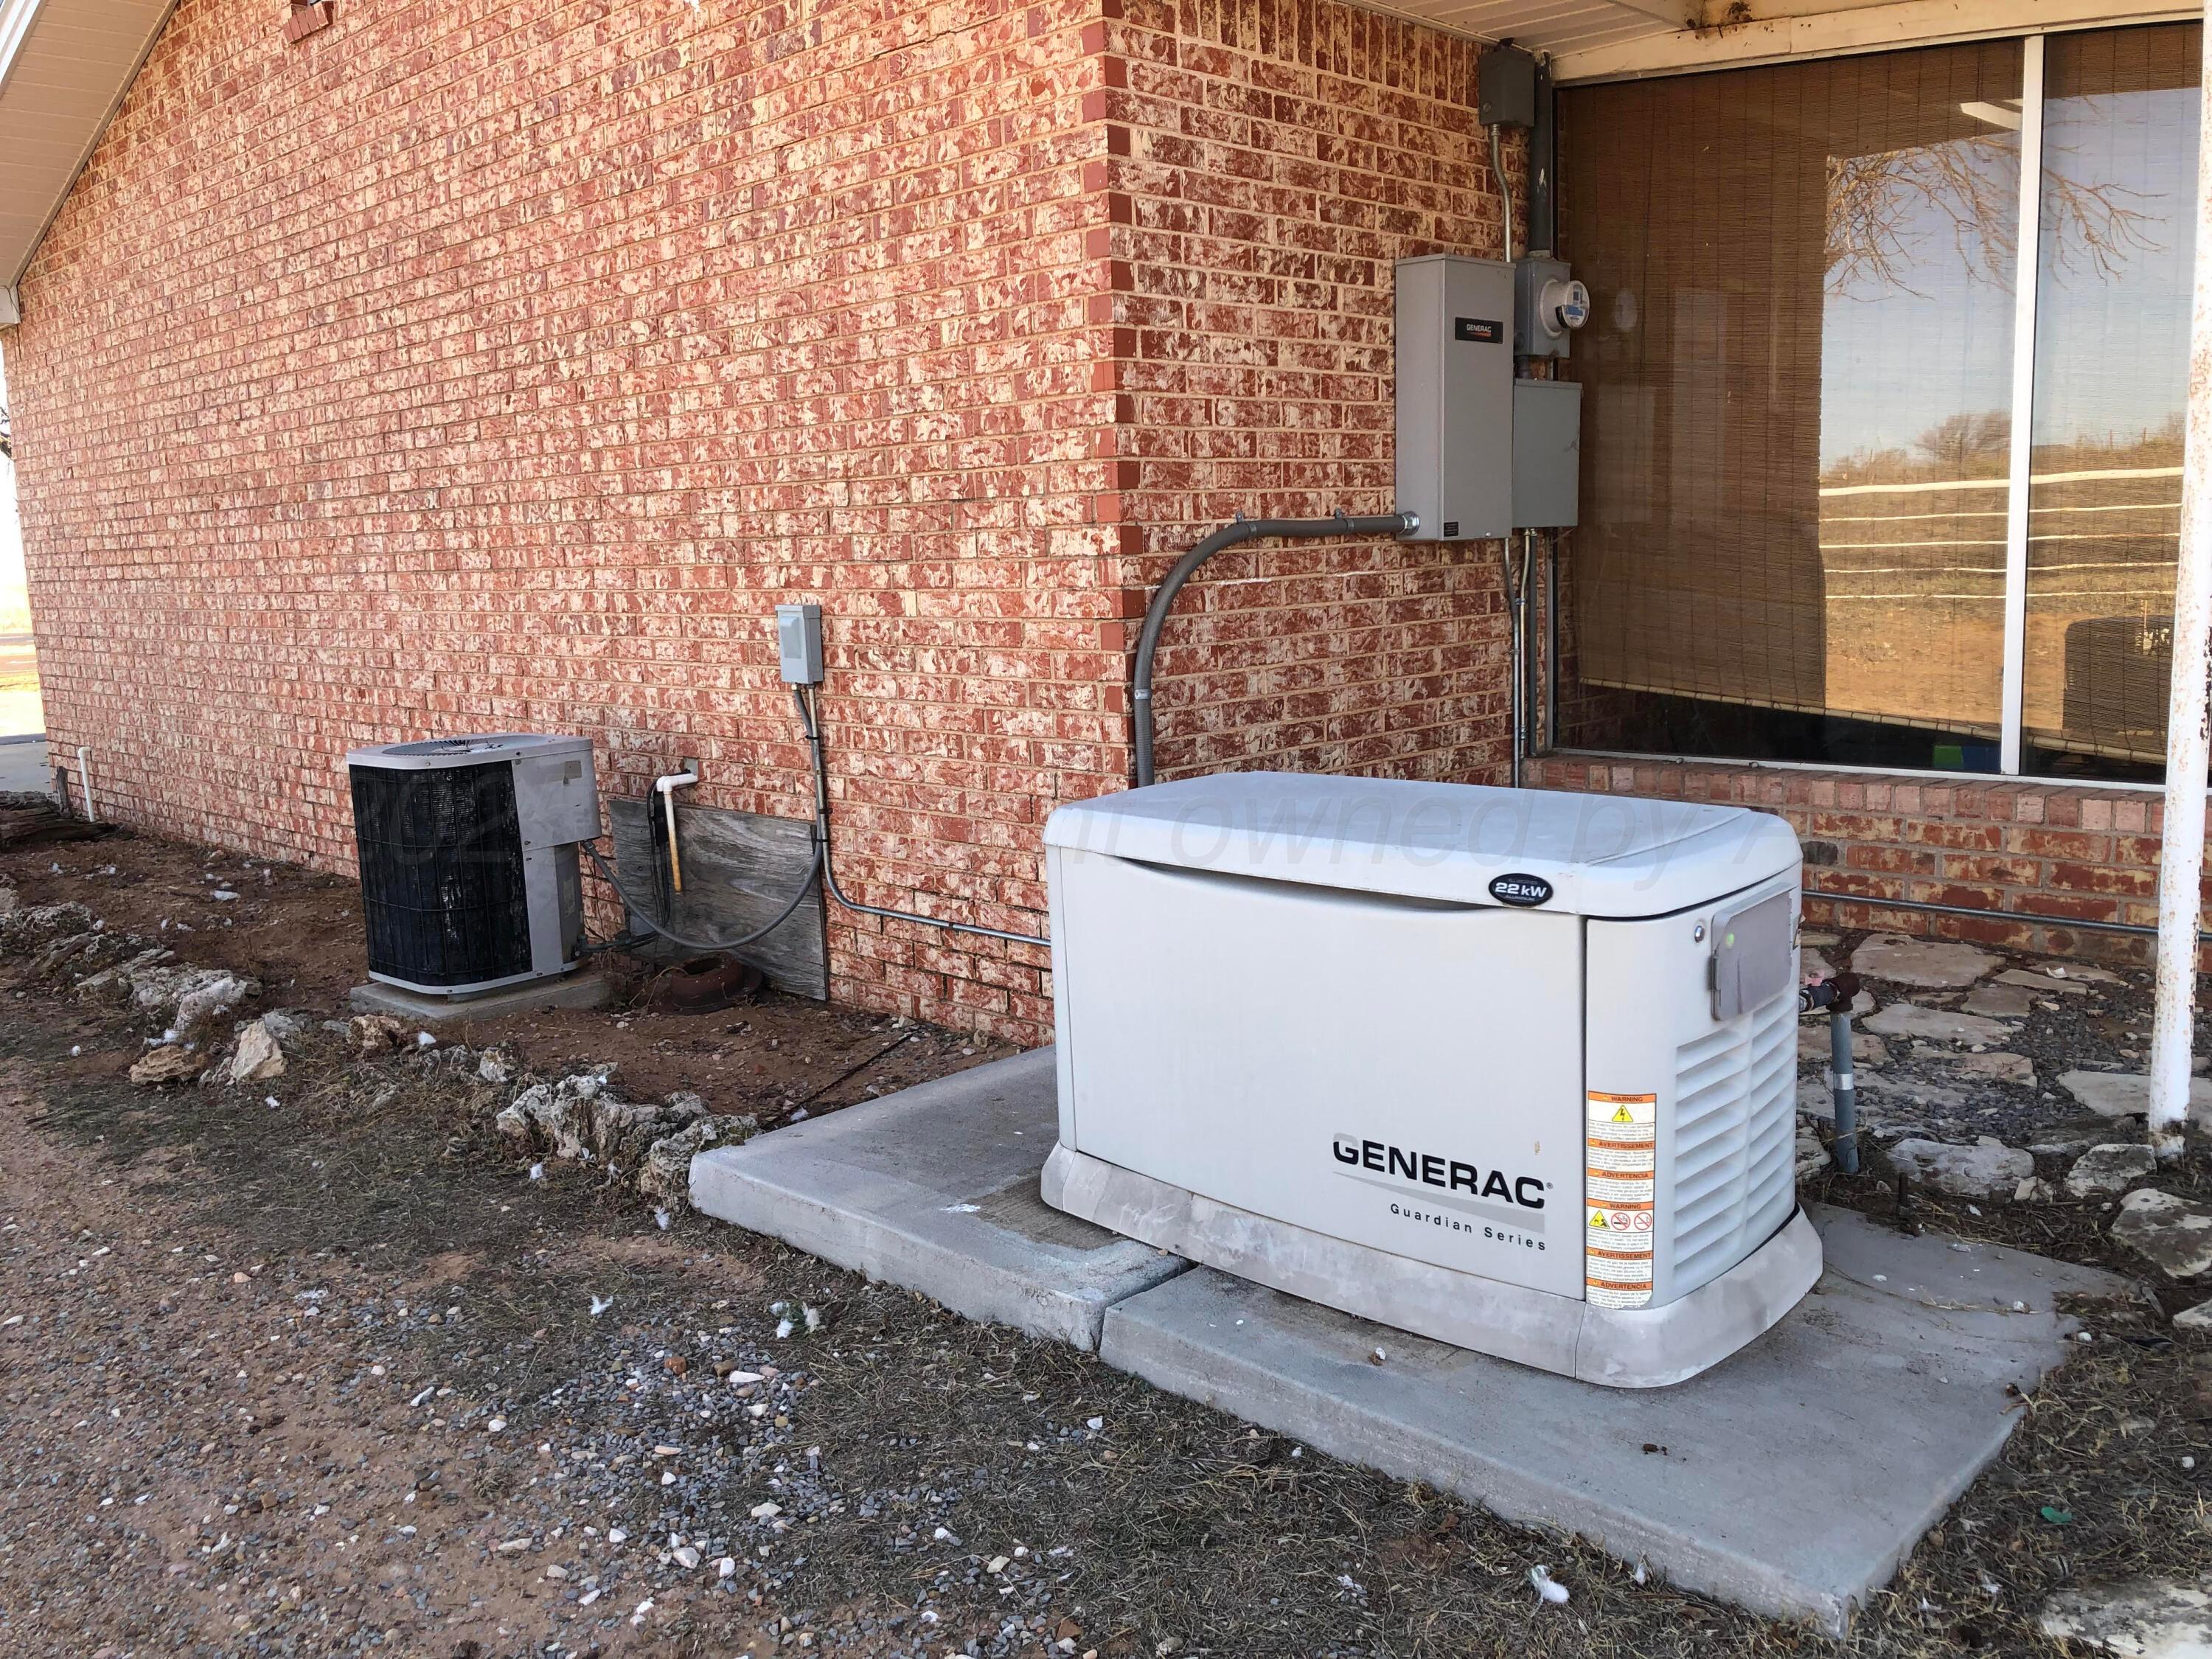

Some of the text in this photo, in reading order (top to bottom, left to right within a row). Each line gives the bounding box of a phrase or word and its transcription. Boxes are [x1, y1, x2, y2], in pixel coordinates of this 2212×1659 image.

[1467, 324, 1492, 333] GENERAC
[1599, 1141, 1652, 1149] AVERTISSEMENT
[1602, 1171, 1648, 1179] ADVERTENCIA
[1391, 1203, 1545, 1251] Guardian Series
[1598, 1251, 1651, 1259] AVERTISSEMENT
[1601, 1281, 1647, 1290] ADVERTENCIA
